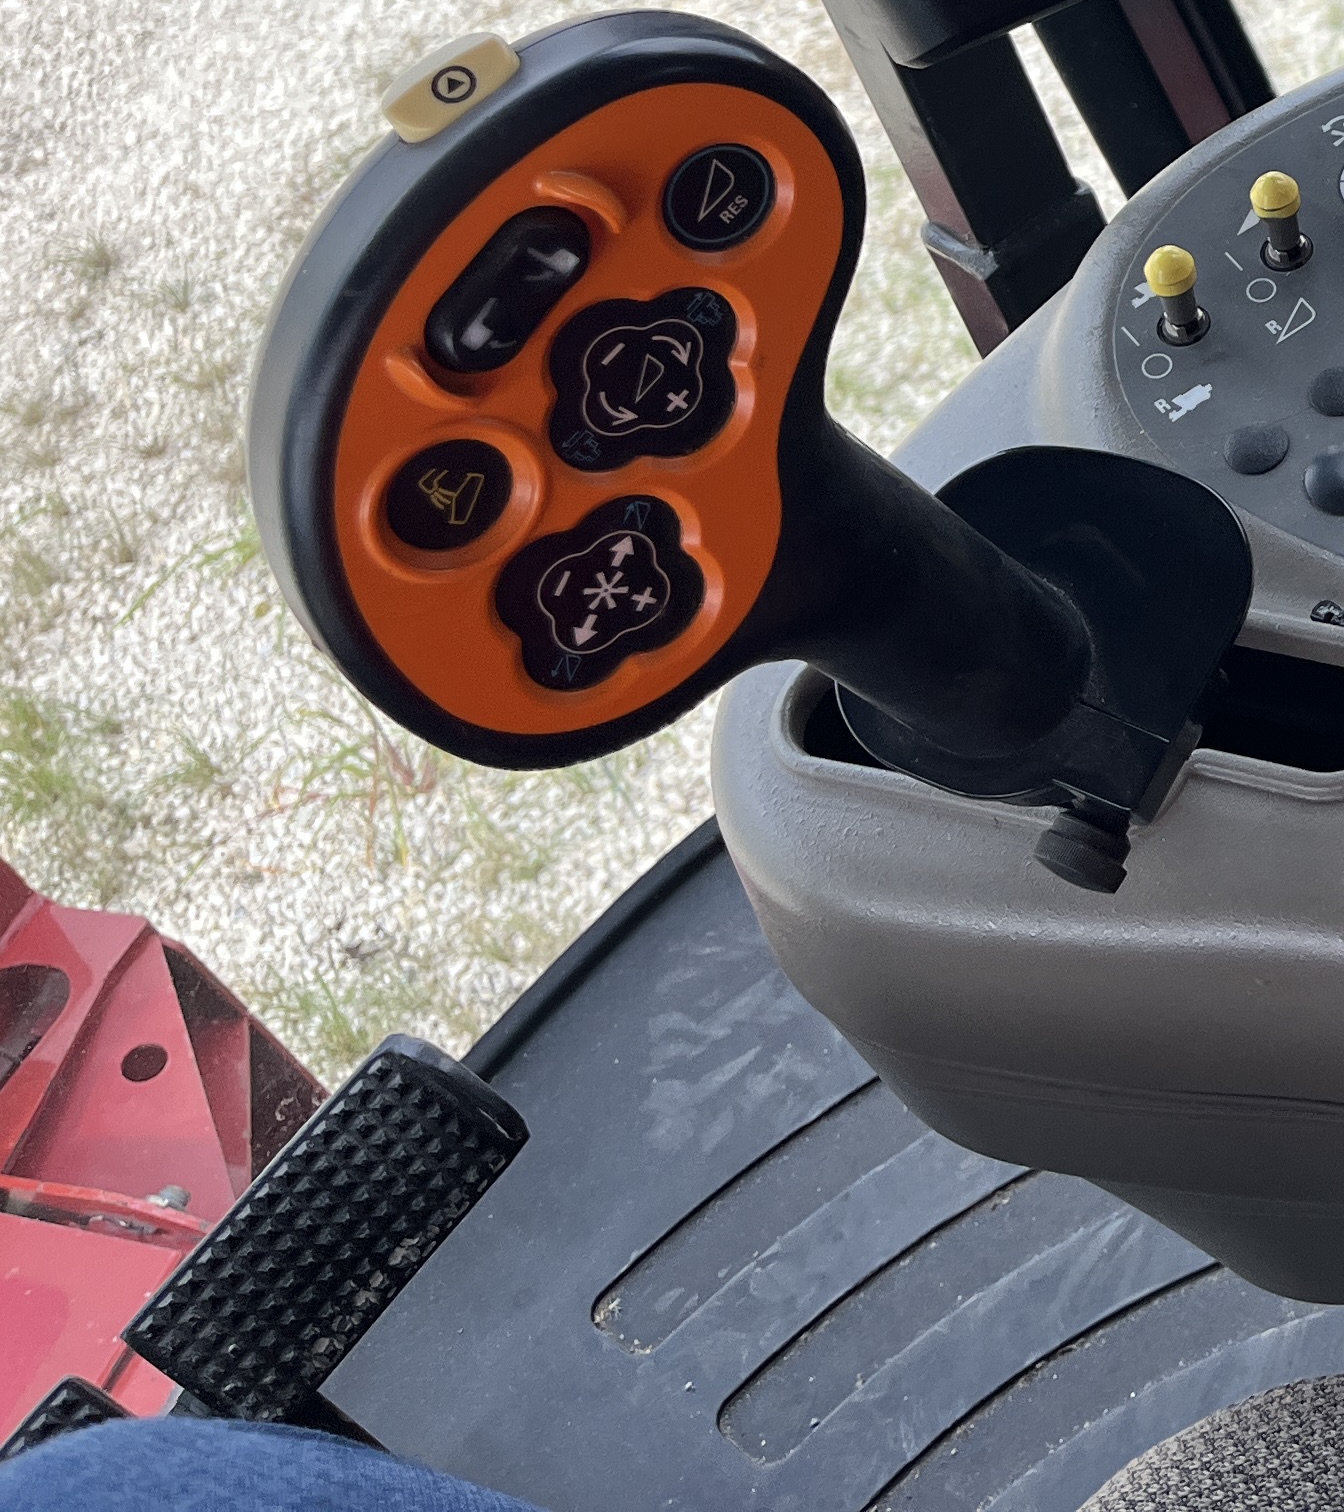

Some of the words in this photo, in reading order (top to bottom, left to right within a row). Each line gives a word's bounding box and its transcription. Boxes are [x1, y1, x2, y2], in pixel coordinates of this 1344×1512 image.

[719, 194, 749, 224] RES
[1265, 319, 1283, 336] R
[1154, 397, 1173, 414] R
